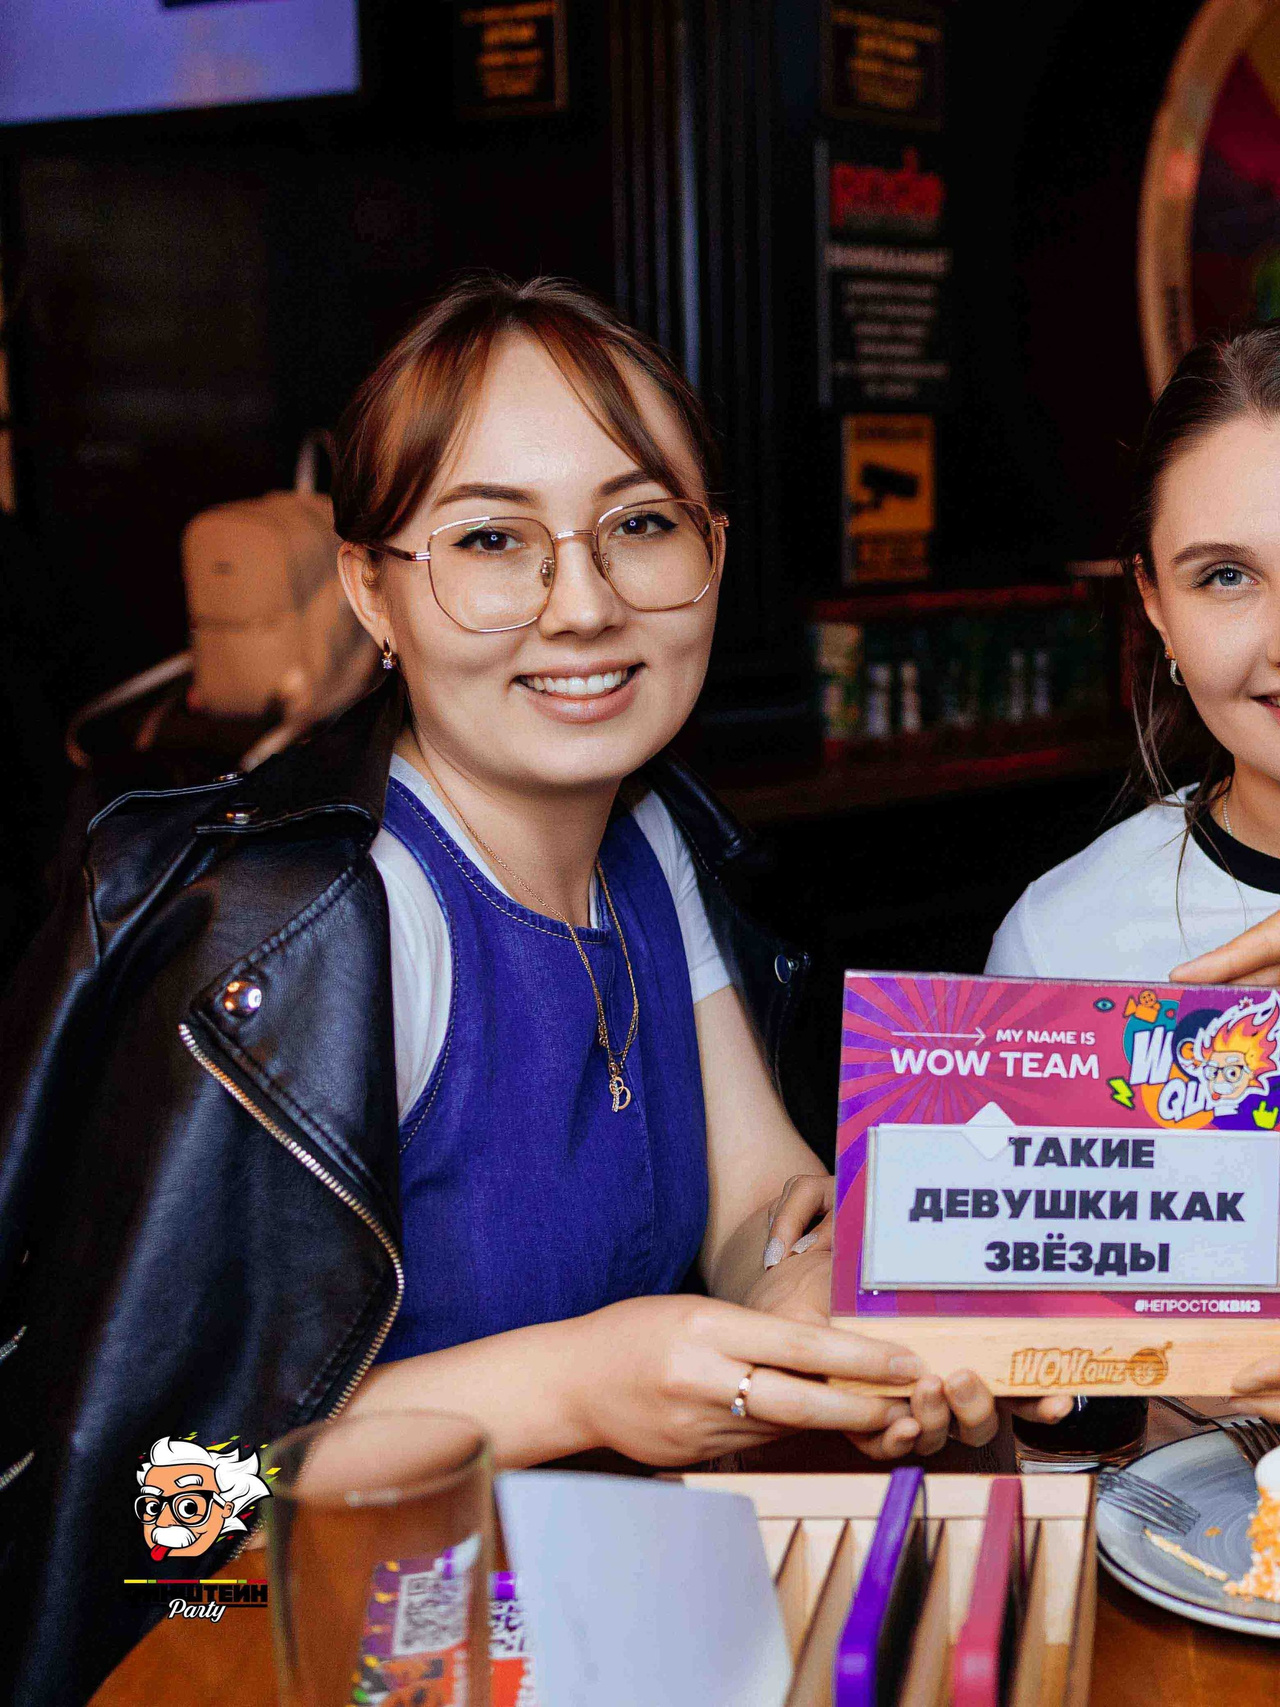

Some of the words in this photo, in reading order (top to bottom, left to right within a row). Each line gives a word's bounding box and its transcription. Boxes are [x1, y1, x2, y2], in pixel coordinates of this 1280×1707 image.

[995, 1029, 1023, 1043] MY
[1026, 1030, 1077, 1045] NAME
[1080, 1032, 1096, 1046] IS
[890, 1048, 991, 1077] WOW
[999, 1051, 1100, 1080] TEAM
[1008, 1136, 1155, 1169] ТАКИЕ
[908, 1187, 1139, 1223] ДЕВУШКИ
[1149, 1191, 1246, 1222] КАК
[984, 1232, 1171, 1277] ЗВЁЗДЫ
[1134, 1299, 1261, 1313] #НЕПРОСТОКВИЗ
